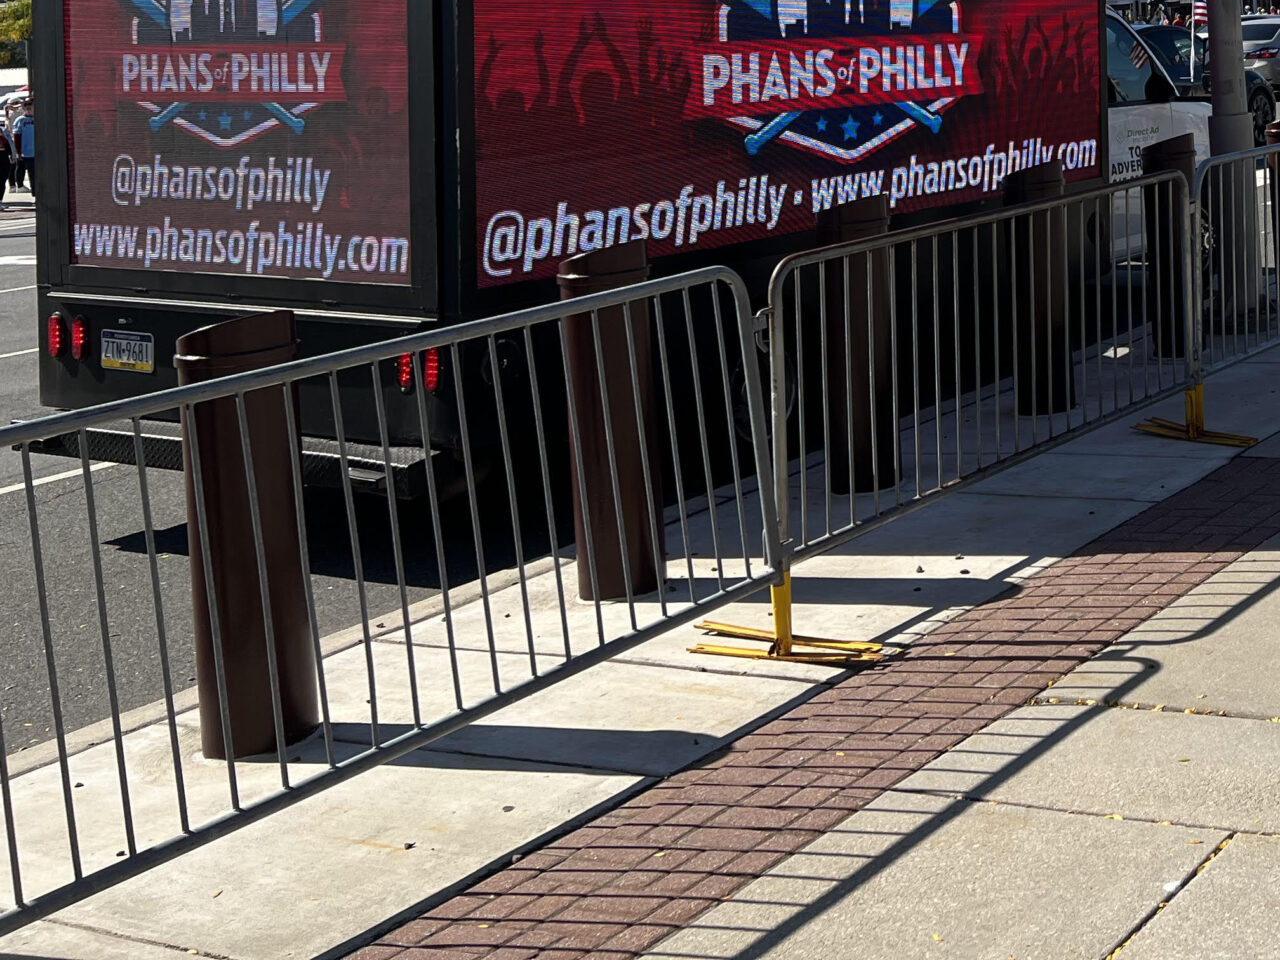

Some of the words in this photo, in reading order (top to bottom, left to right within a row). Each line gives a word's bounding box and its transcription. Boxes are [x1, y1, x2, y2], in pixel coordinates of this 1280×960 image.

[123, 51, 213, 93] PHANS
[214, 63, 229, 85] of
[231, 51, 332, 92] PHILLY
[702, 50, 835, 107] PHANS
[837, 57, 857, 84] of
[859, 43, 969, 96] PHILLY
[1127, 128, 1150, 138] Direct
[111, 153, 331, 213] @phansofphilly
[482, 175, 788, 277] @phansofphilly
[811, 137, 1097, 213] www.phansofphilly.com
[74, 220, 409, 279] www.phansofphilly.com
